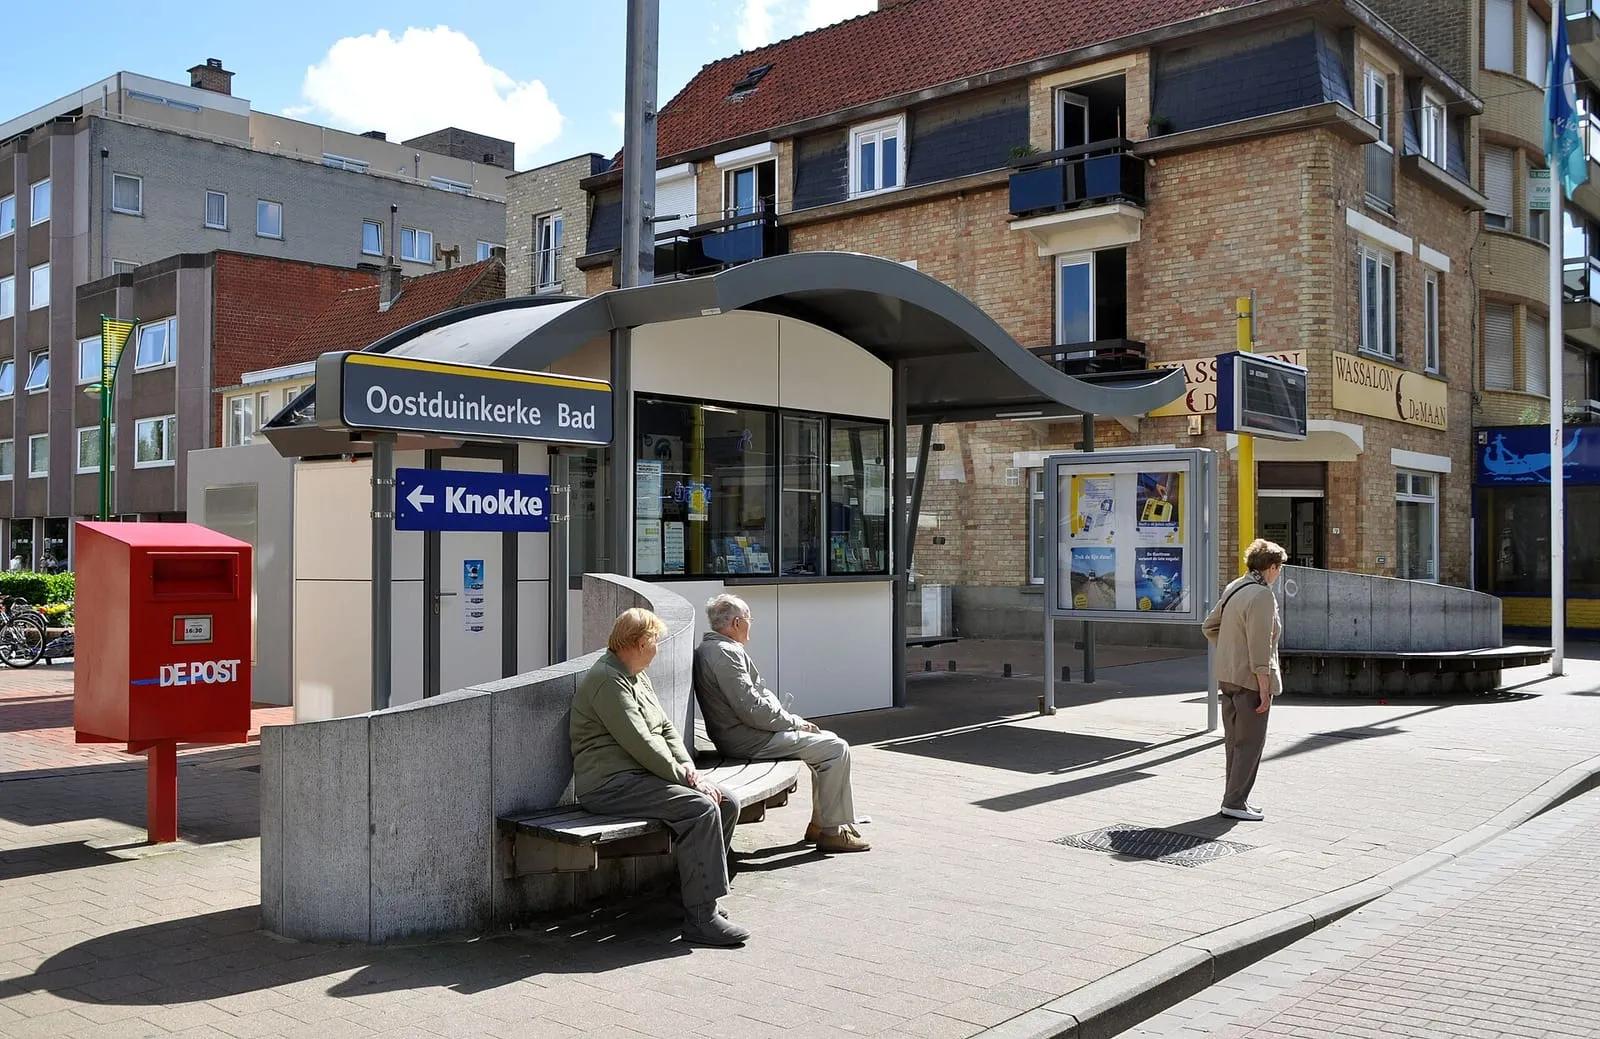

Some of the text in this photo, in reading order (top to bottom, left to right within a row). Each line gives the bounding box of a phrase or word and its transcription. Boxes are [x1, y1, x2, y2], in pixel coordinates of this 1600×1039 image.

[1335, 356, 1393, 392] WASSALON
[366, 385, 595, 429] Oostduinkerke Bad
[445, 486, 543, 516] Knokke
[160, 659, 241, 688] DE POST
